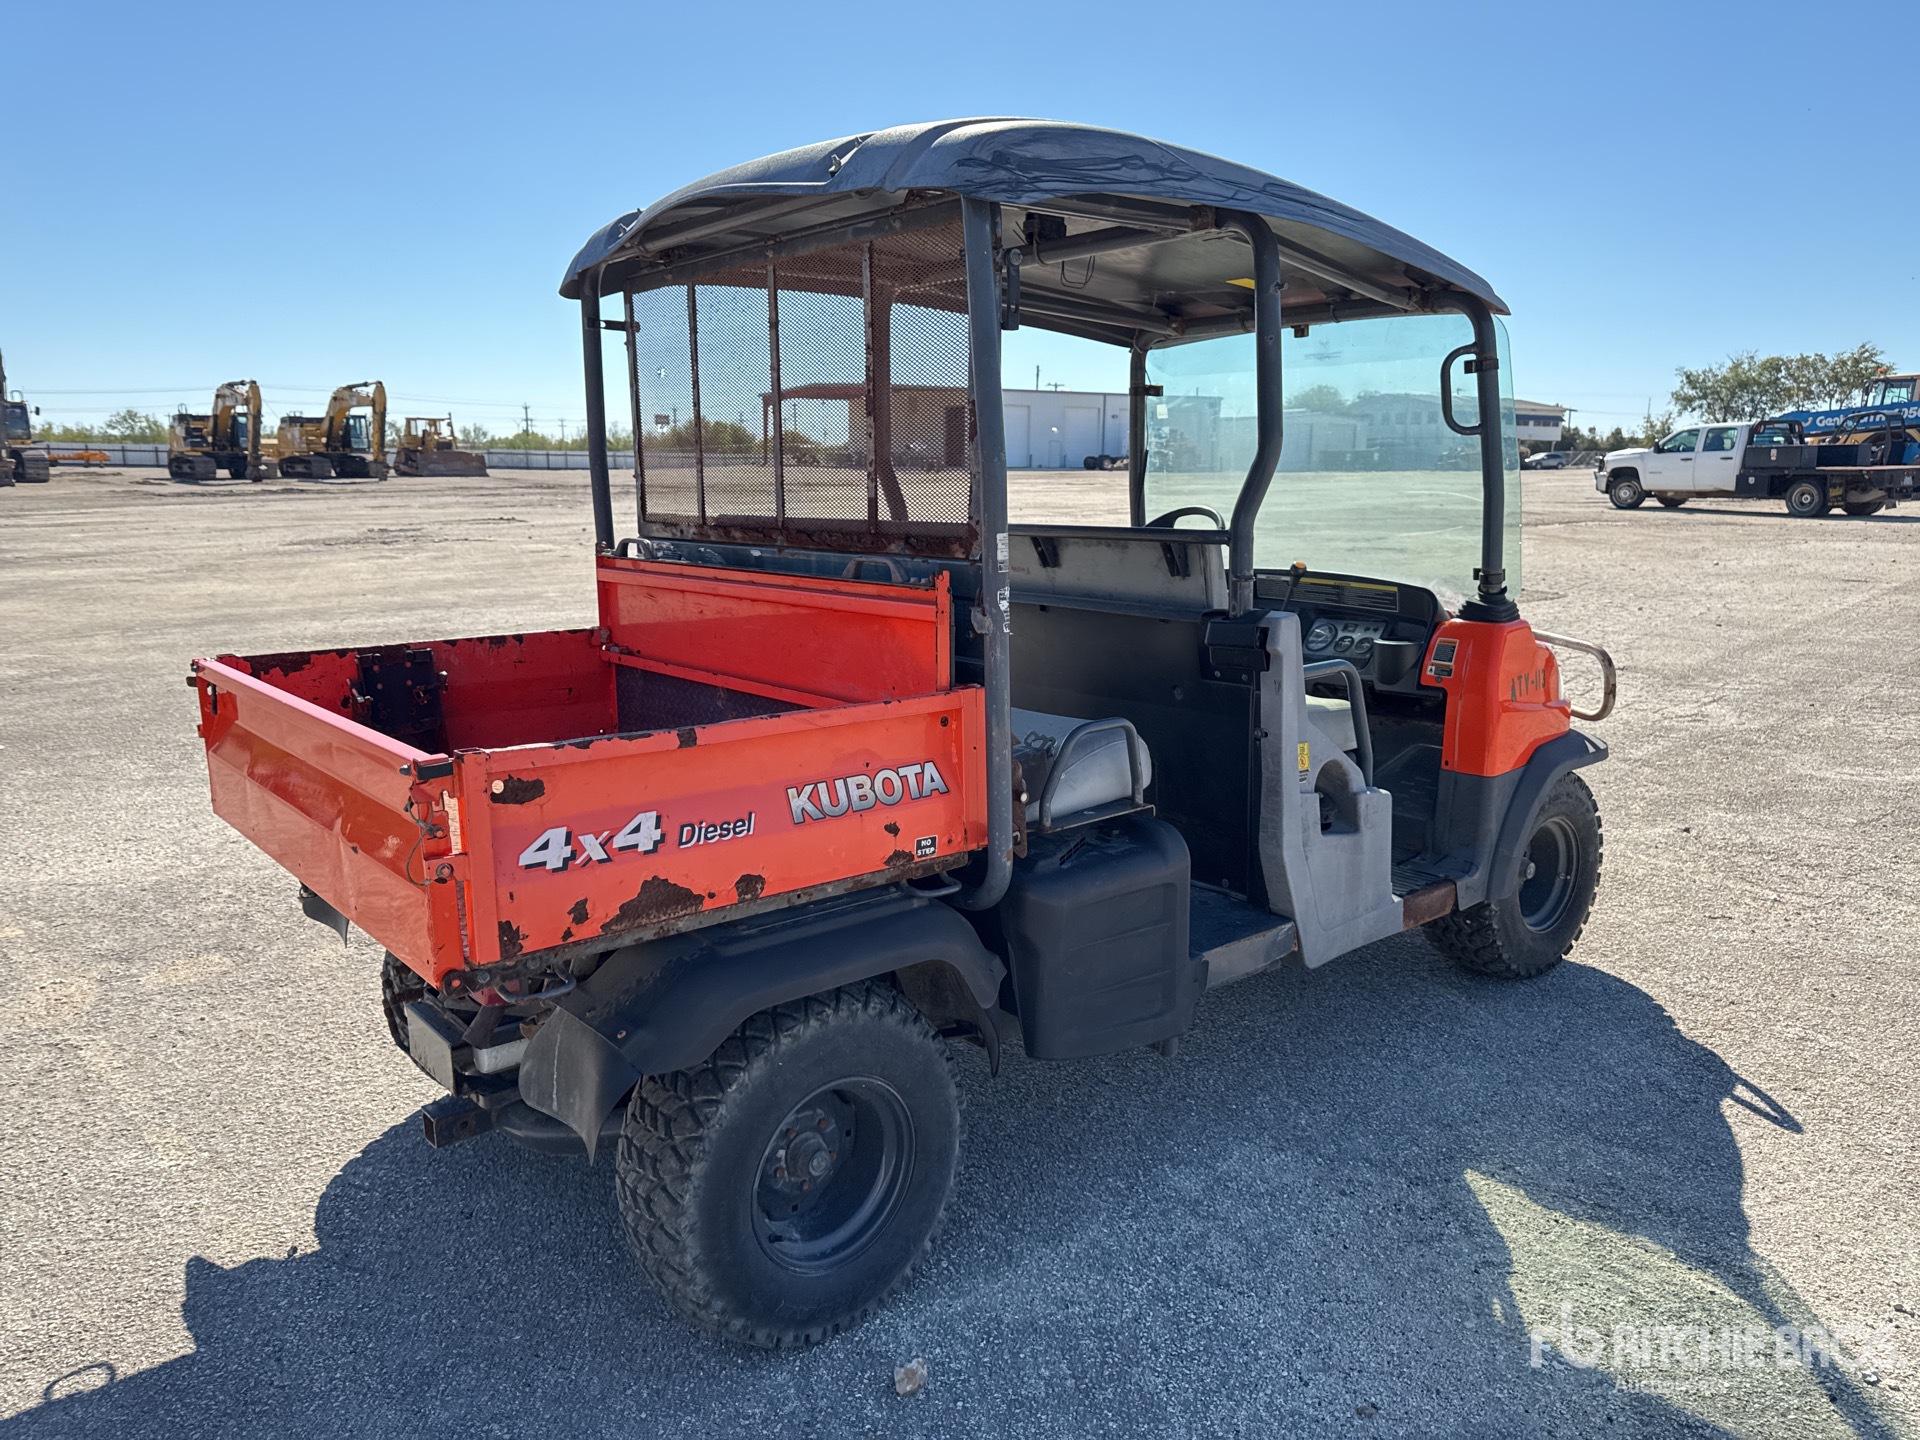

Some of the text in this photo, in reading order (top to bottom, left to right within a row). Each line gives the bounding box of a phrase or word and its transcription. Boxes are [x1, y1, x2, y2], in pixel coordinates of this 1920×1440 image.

[1511, 668, 1546, 702] ATV-113
[786, 760, 950, 825] KUBOTA
[518, 811, 666, 873] 4x4
[678, 811, 756, 848] Diesel
[917, 847, 935, 856] STEP
[921, 839, 931, 847] NO
